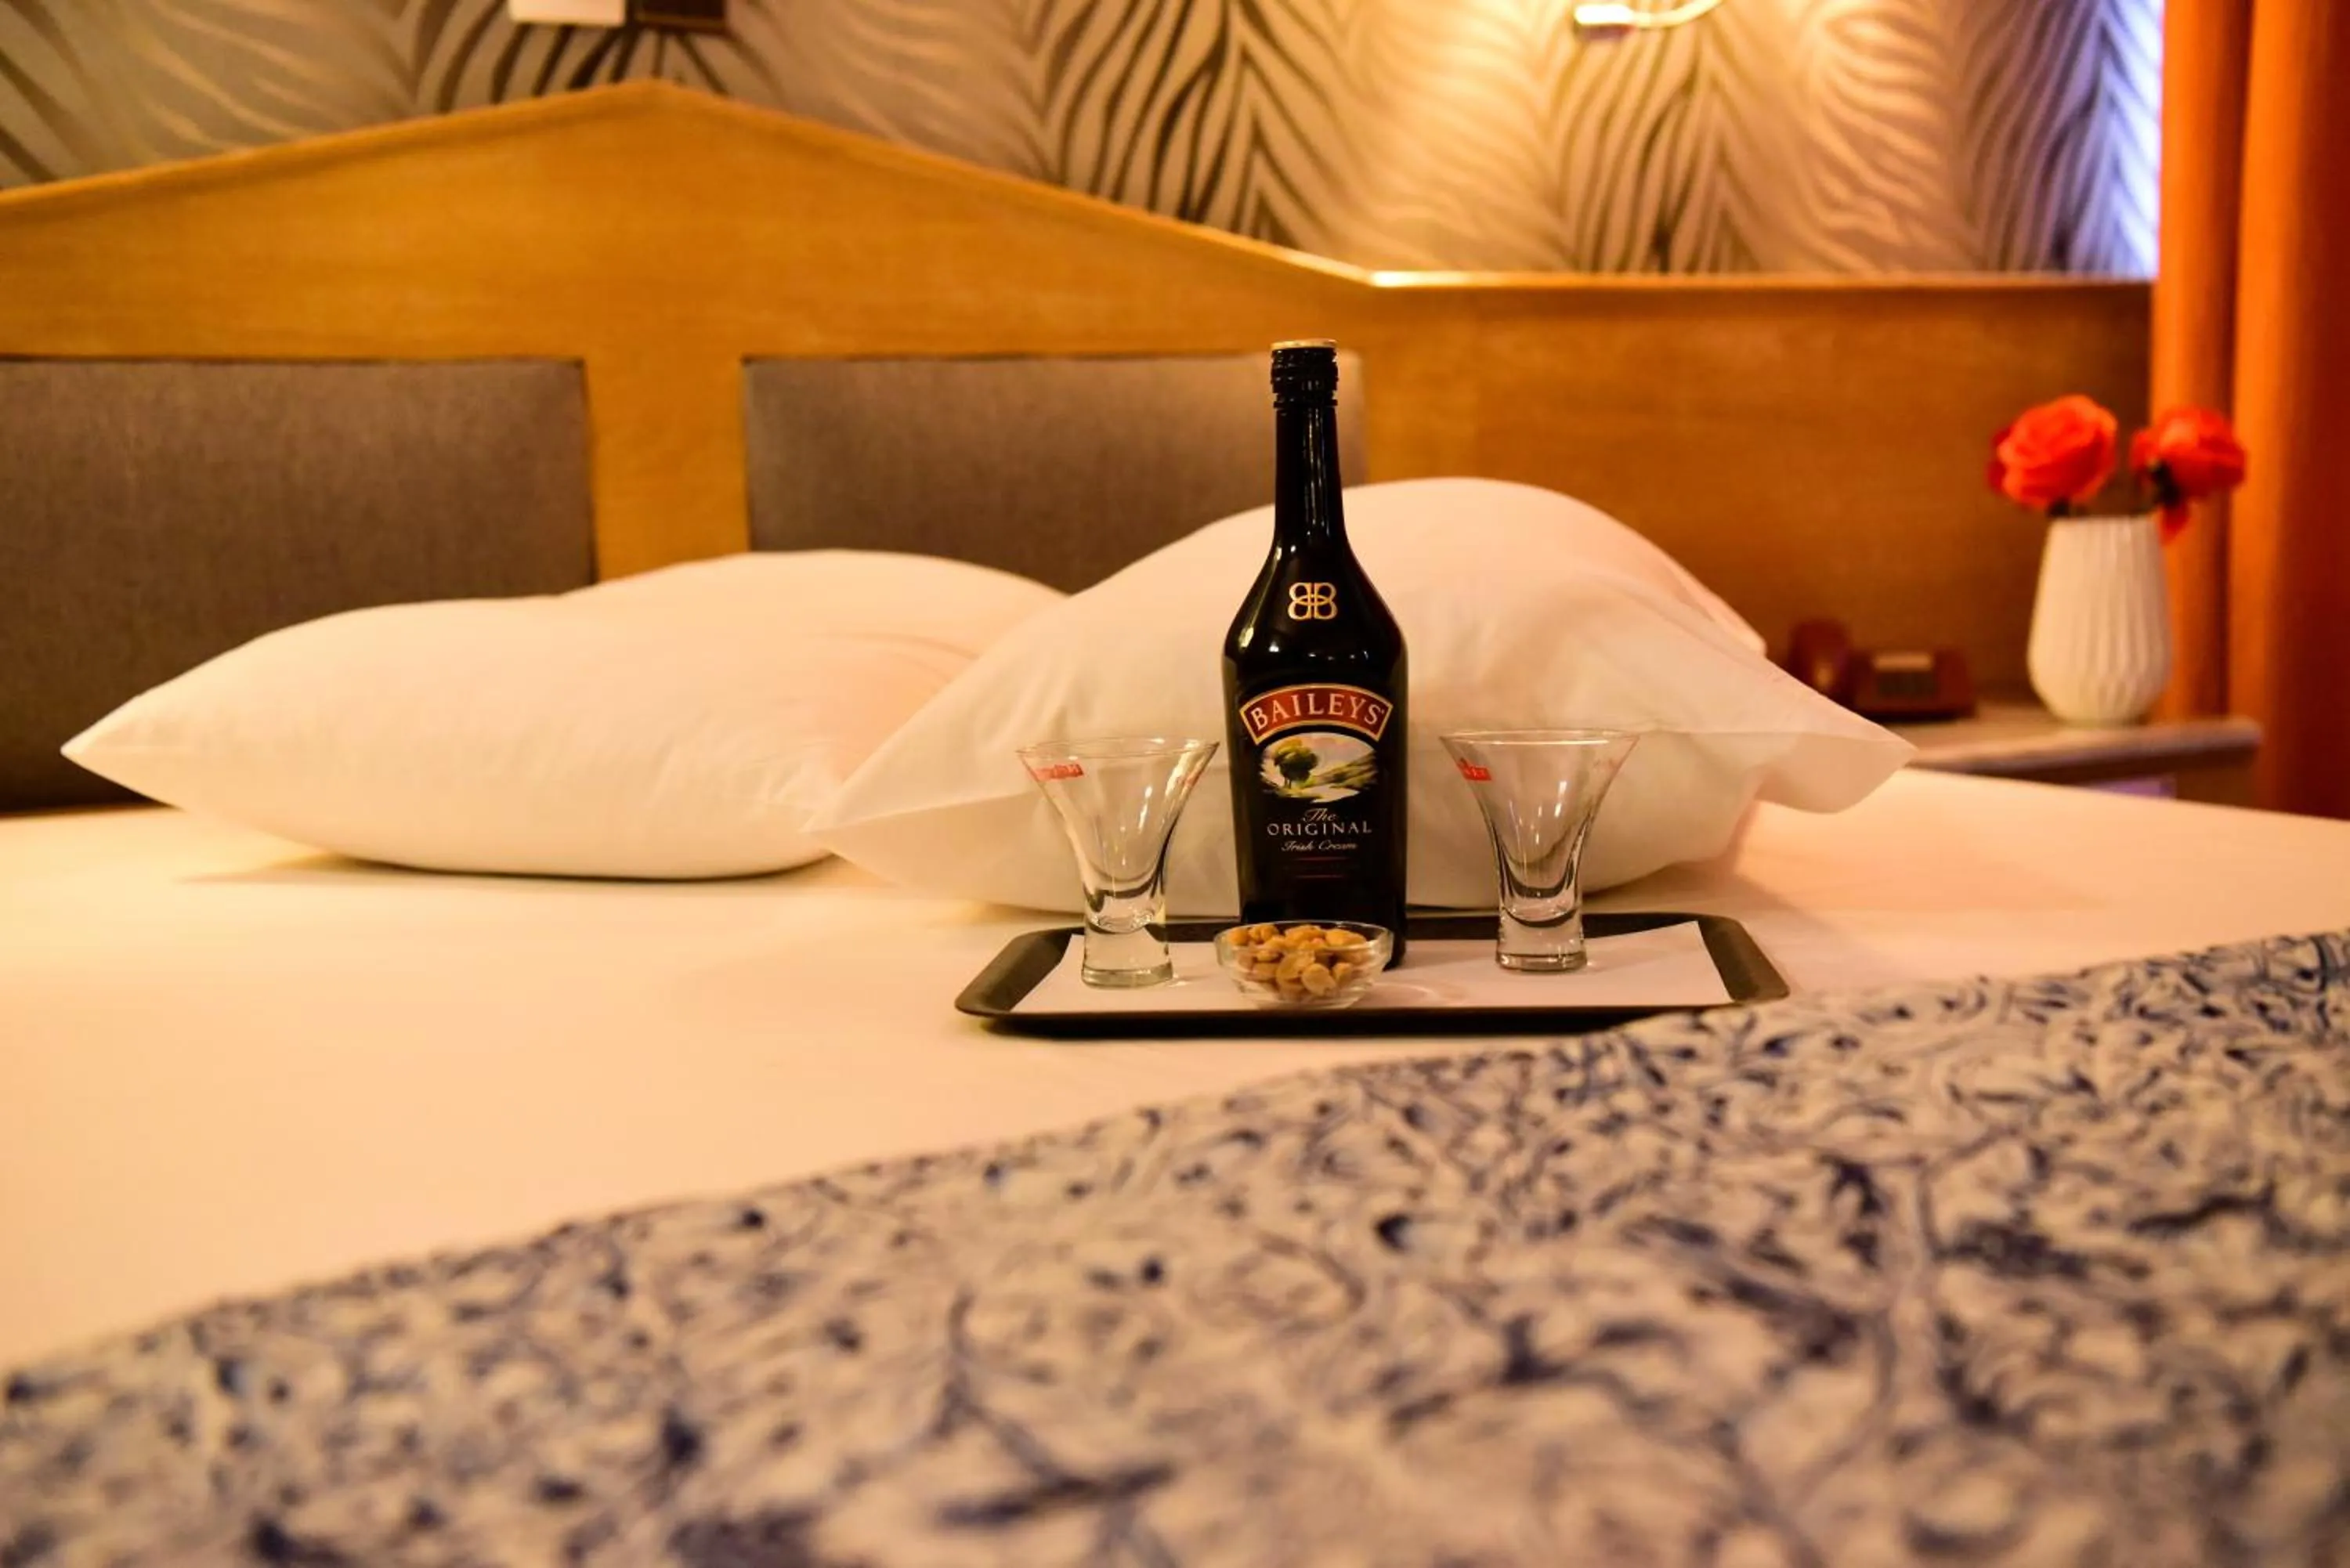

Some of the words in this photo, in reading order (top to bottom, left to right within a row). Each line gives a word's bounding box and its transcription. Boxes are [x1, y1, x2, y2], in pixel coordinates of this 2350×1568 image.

[1250, 692, 1384, 731] BAILEYS
[1302, 807, 1336, 822] The
[1267, 820, 1372, 836] ORIGINAL
[1281, 840, 1314, 852] Irish
[1318, 839, 1358, 851] Cream
